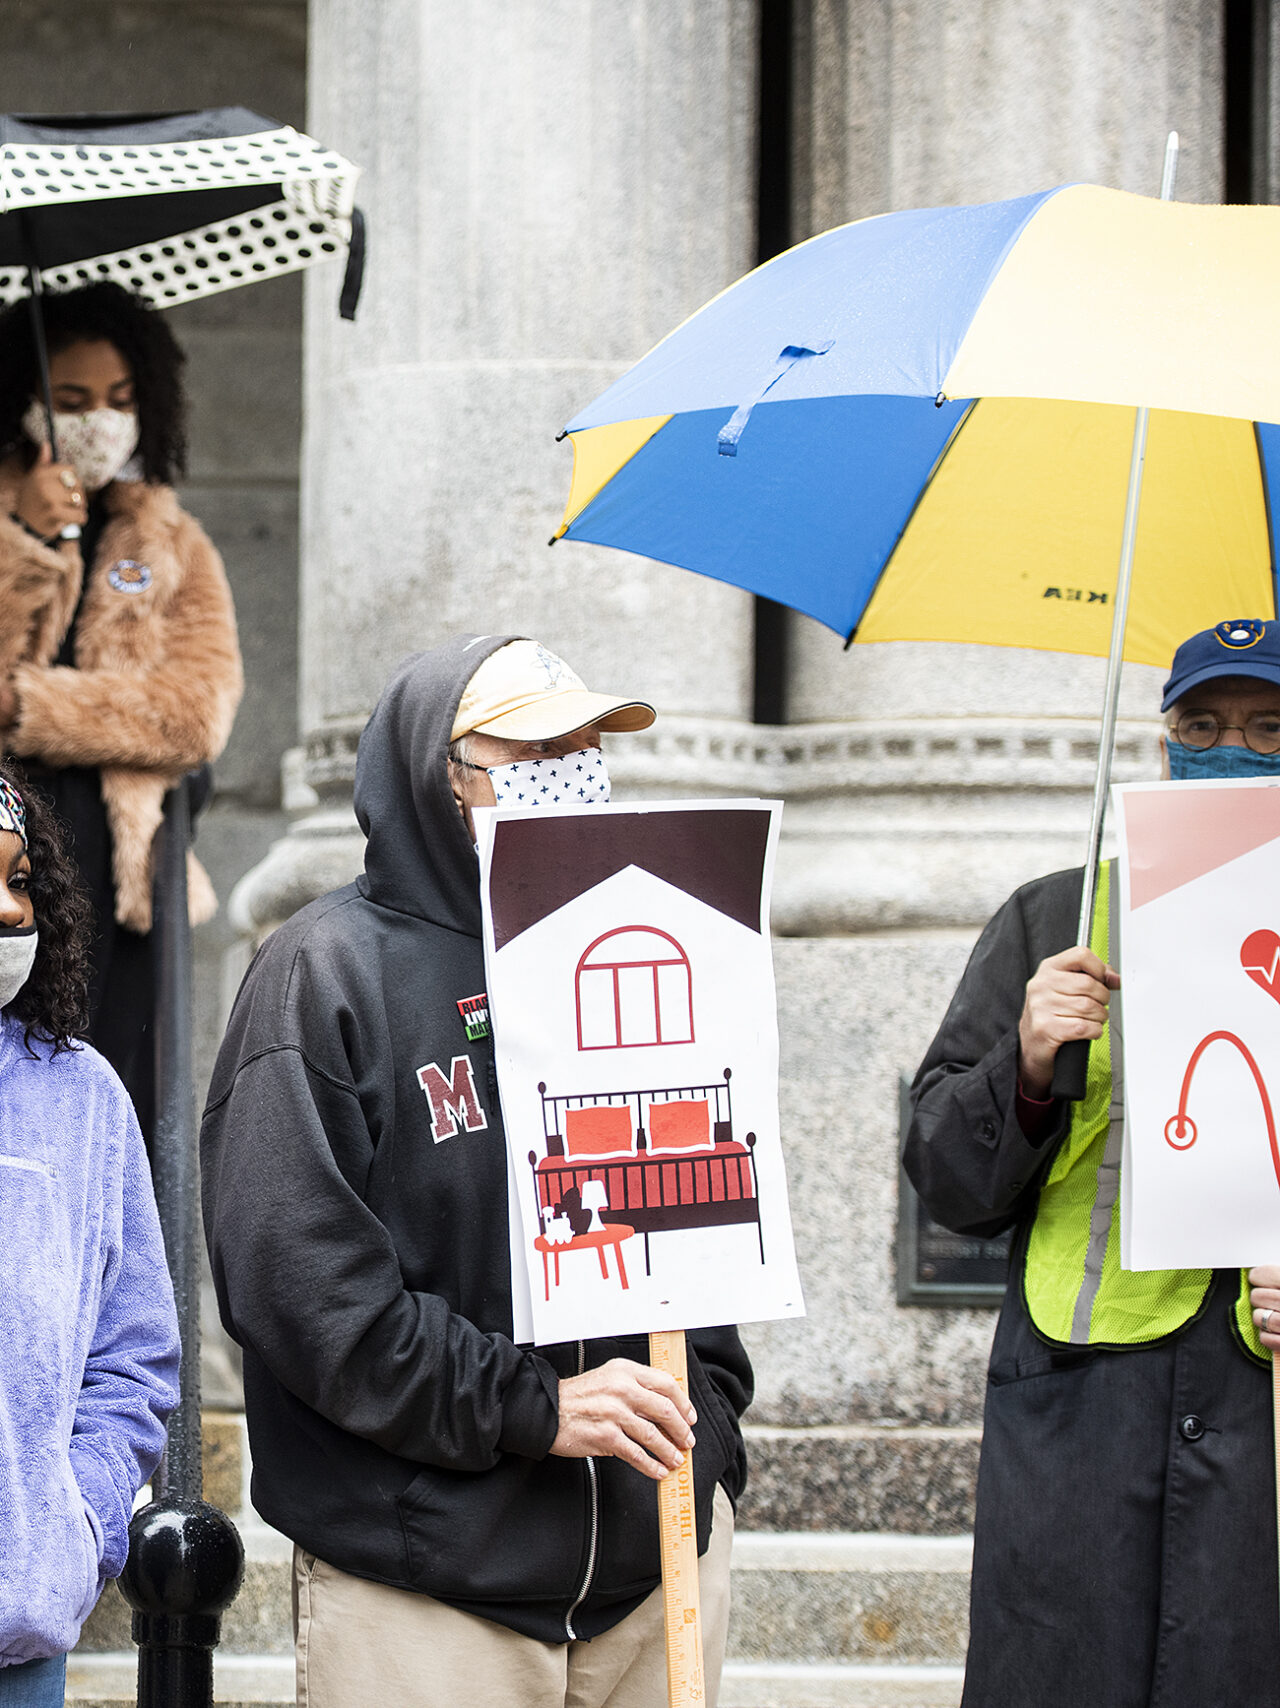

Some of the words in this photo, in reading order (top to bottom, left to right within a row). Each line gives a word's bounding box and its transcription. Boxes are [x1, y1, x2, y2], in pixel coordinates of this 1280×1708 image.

[462, 997, 488, 1014] BLAC
[464, 1008, 488, 1026] LIV
[469, 1023, 488, 1038] MAT
[416, 1054, 488, 1144] M
[677, 1449, 690, 1497] HOM
[680, 1502, 692, 1542] THE
